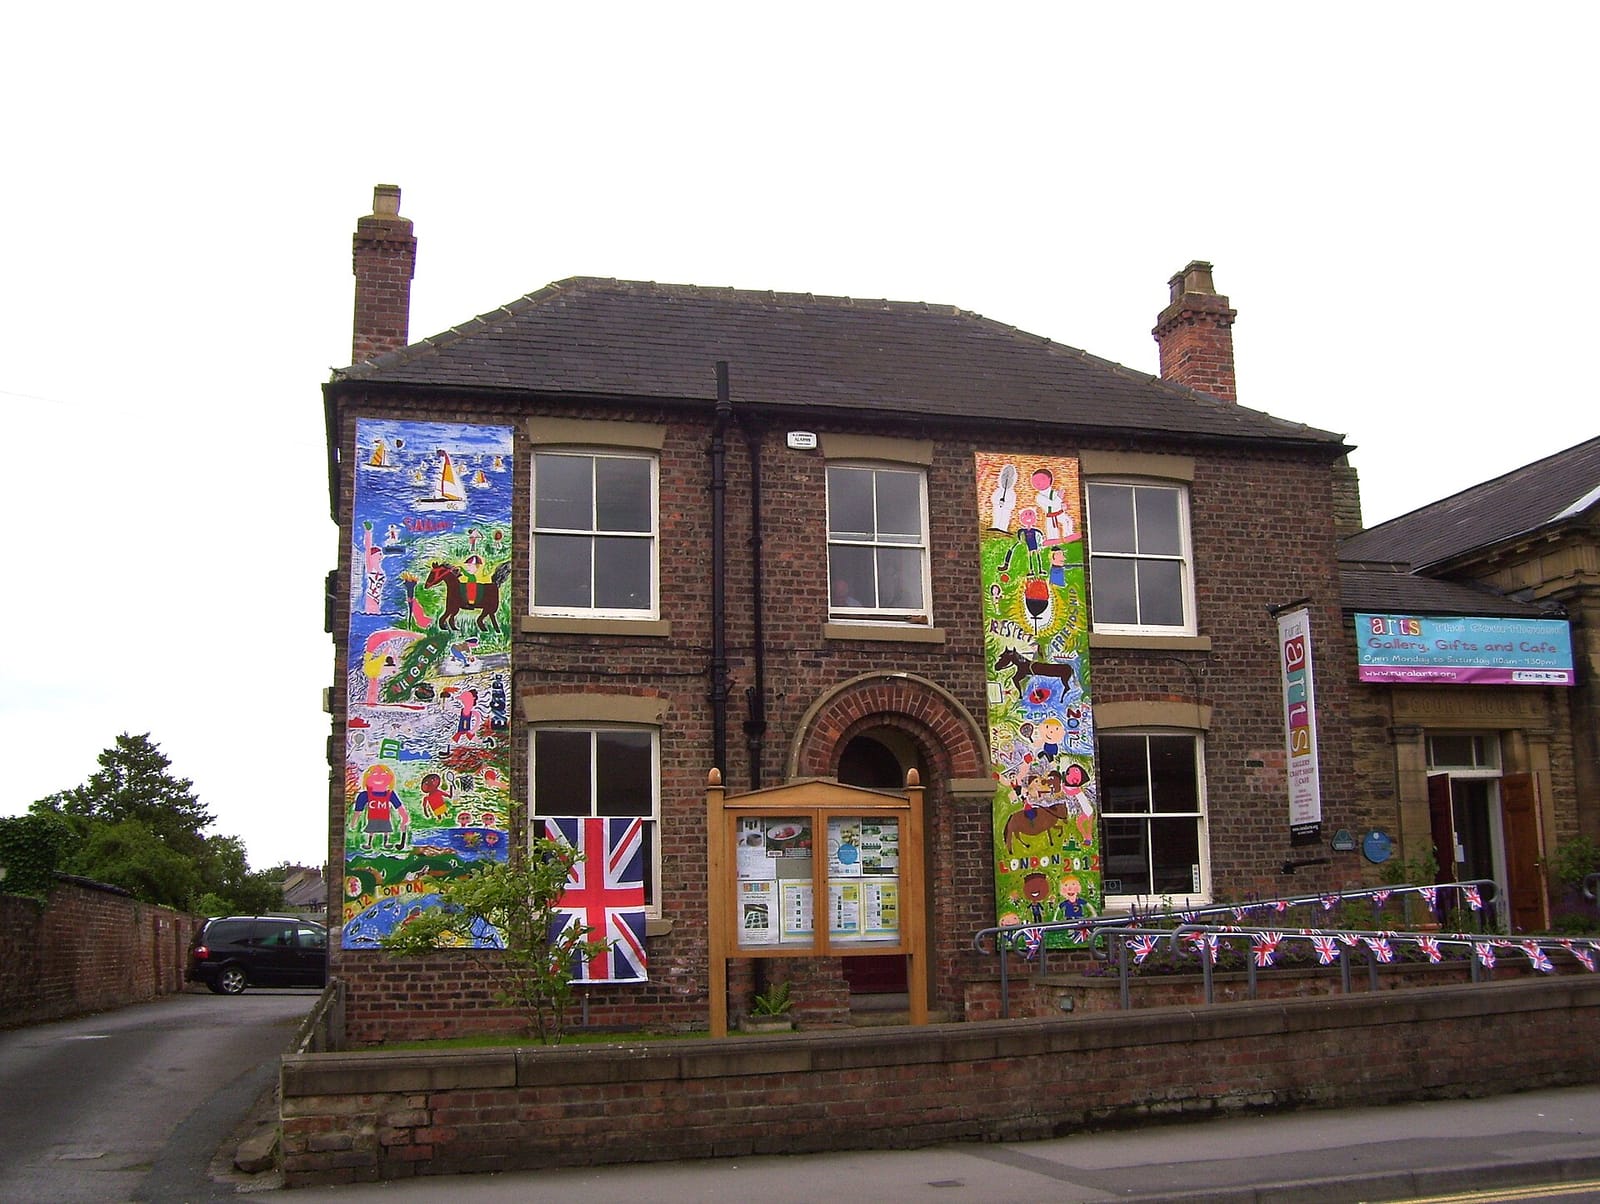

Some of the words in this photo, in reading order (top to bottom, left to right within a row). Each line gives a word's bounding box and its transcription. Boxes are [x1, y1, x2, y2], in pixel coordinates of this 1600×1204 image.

[1371, 618, 1421, 636] arts
[1367, 638, 1430, 653] Gallery,
[1436, 640, 1477, 651] Gifts
[1485, 642, 1513, 652] and
[1520, 642, 1557, 653] Cafe
[1363, 654, 1388, 663] Open
[1392, 655, 1430, 664] Monday
[1448, 656, 1490, 665] Saturday
[1364, 670, 1456, 679] www.ruralarts.org
[1285, 641, 1309, 753] arts
[998, 854, 1060, 874] LONDON
[1063, 855, 1100, 872] 2012
[375, 883, 424, 898] LONDON
